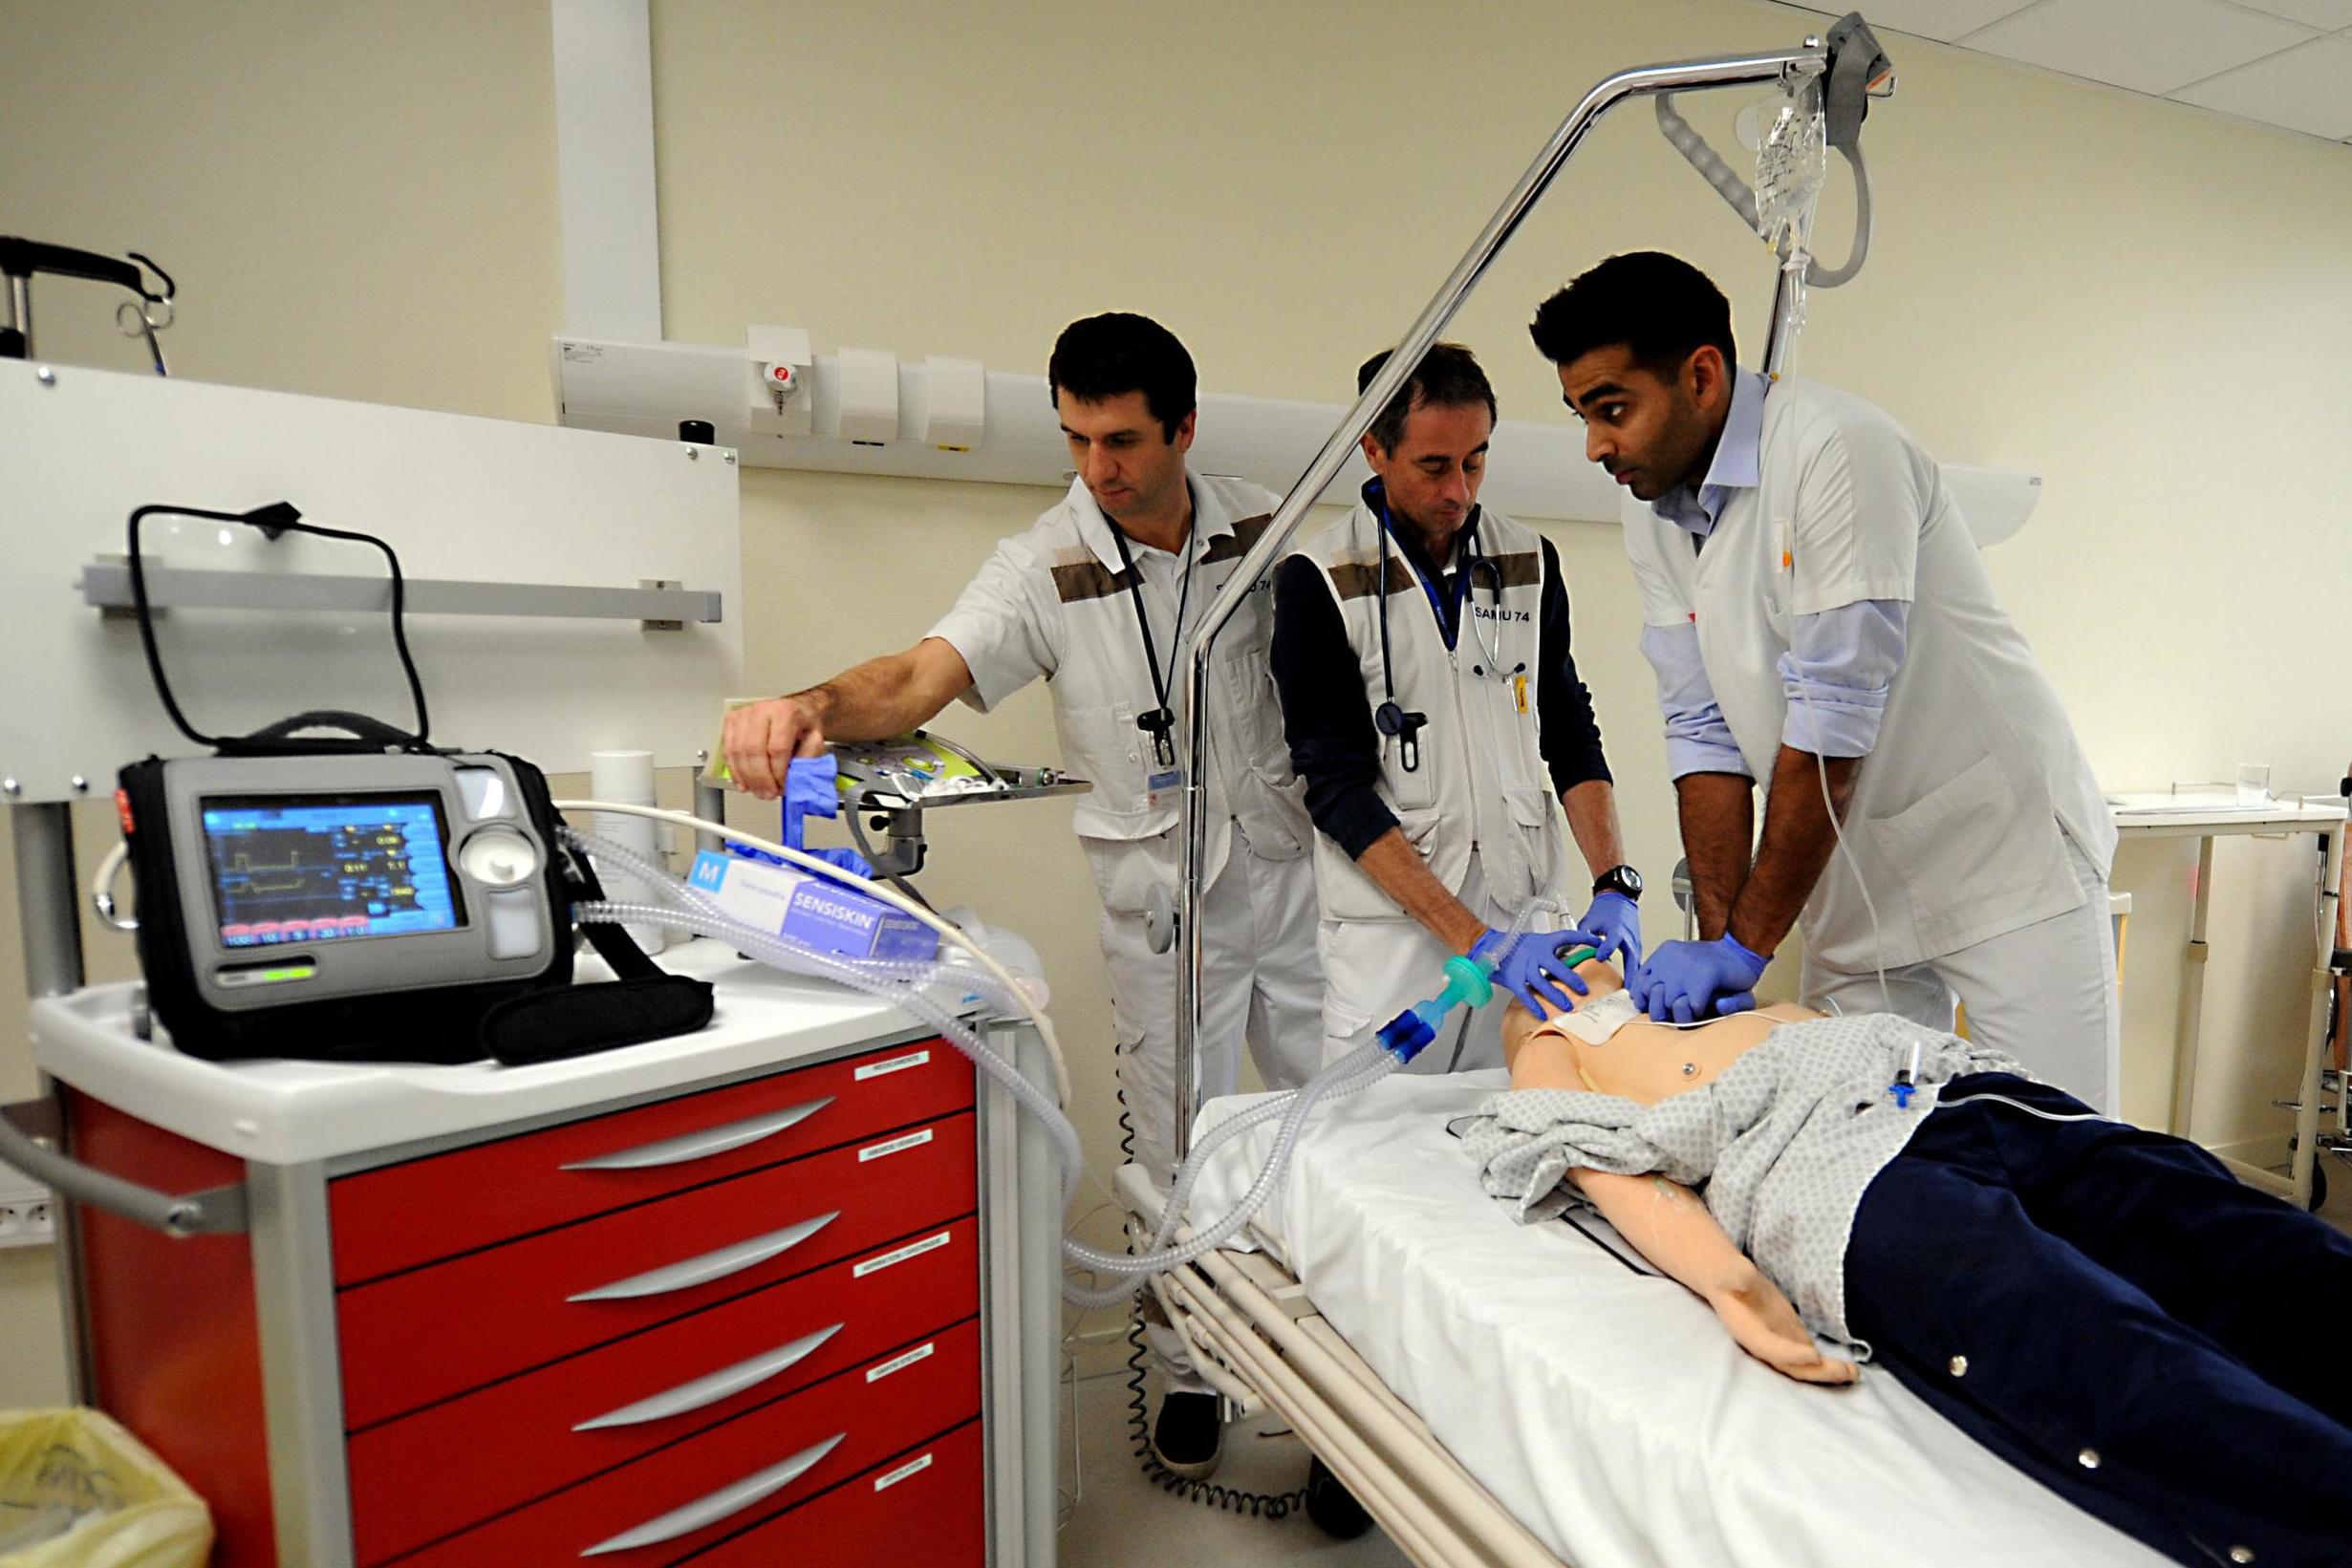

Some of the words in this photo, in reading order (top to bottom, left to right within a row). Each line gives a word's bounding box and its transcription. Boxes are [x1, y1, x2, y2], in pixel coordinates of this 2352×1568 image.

[1475, 606, 1511, 621] SAMU
[1515, 611, 1530, 622] 74
[699, 862, 720, 883] M
[793, 892, 873, 930] SENSISKIN
